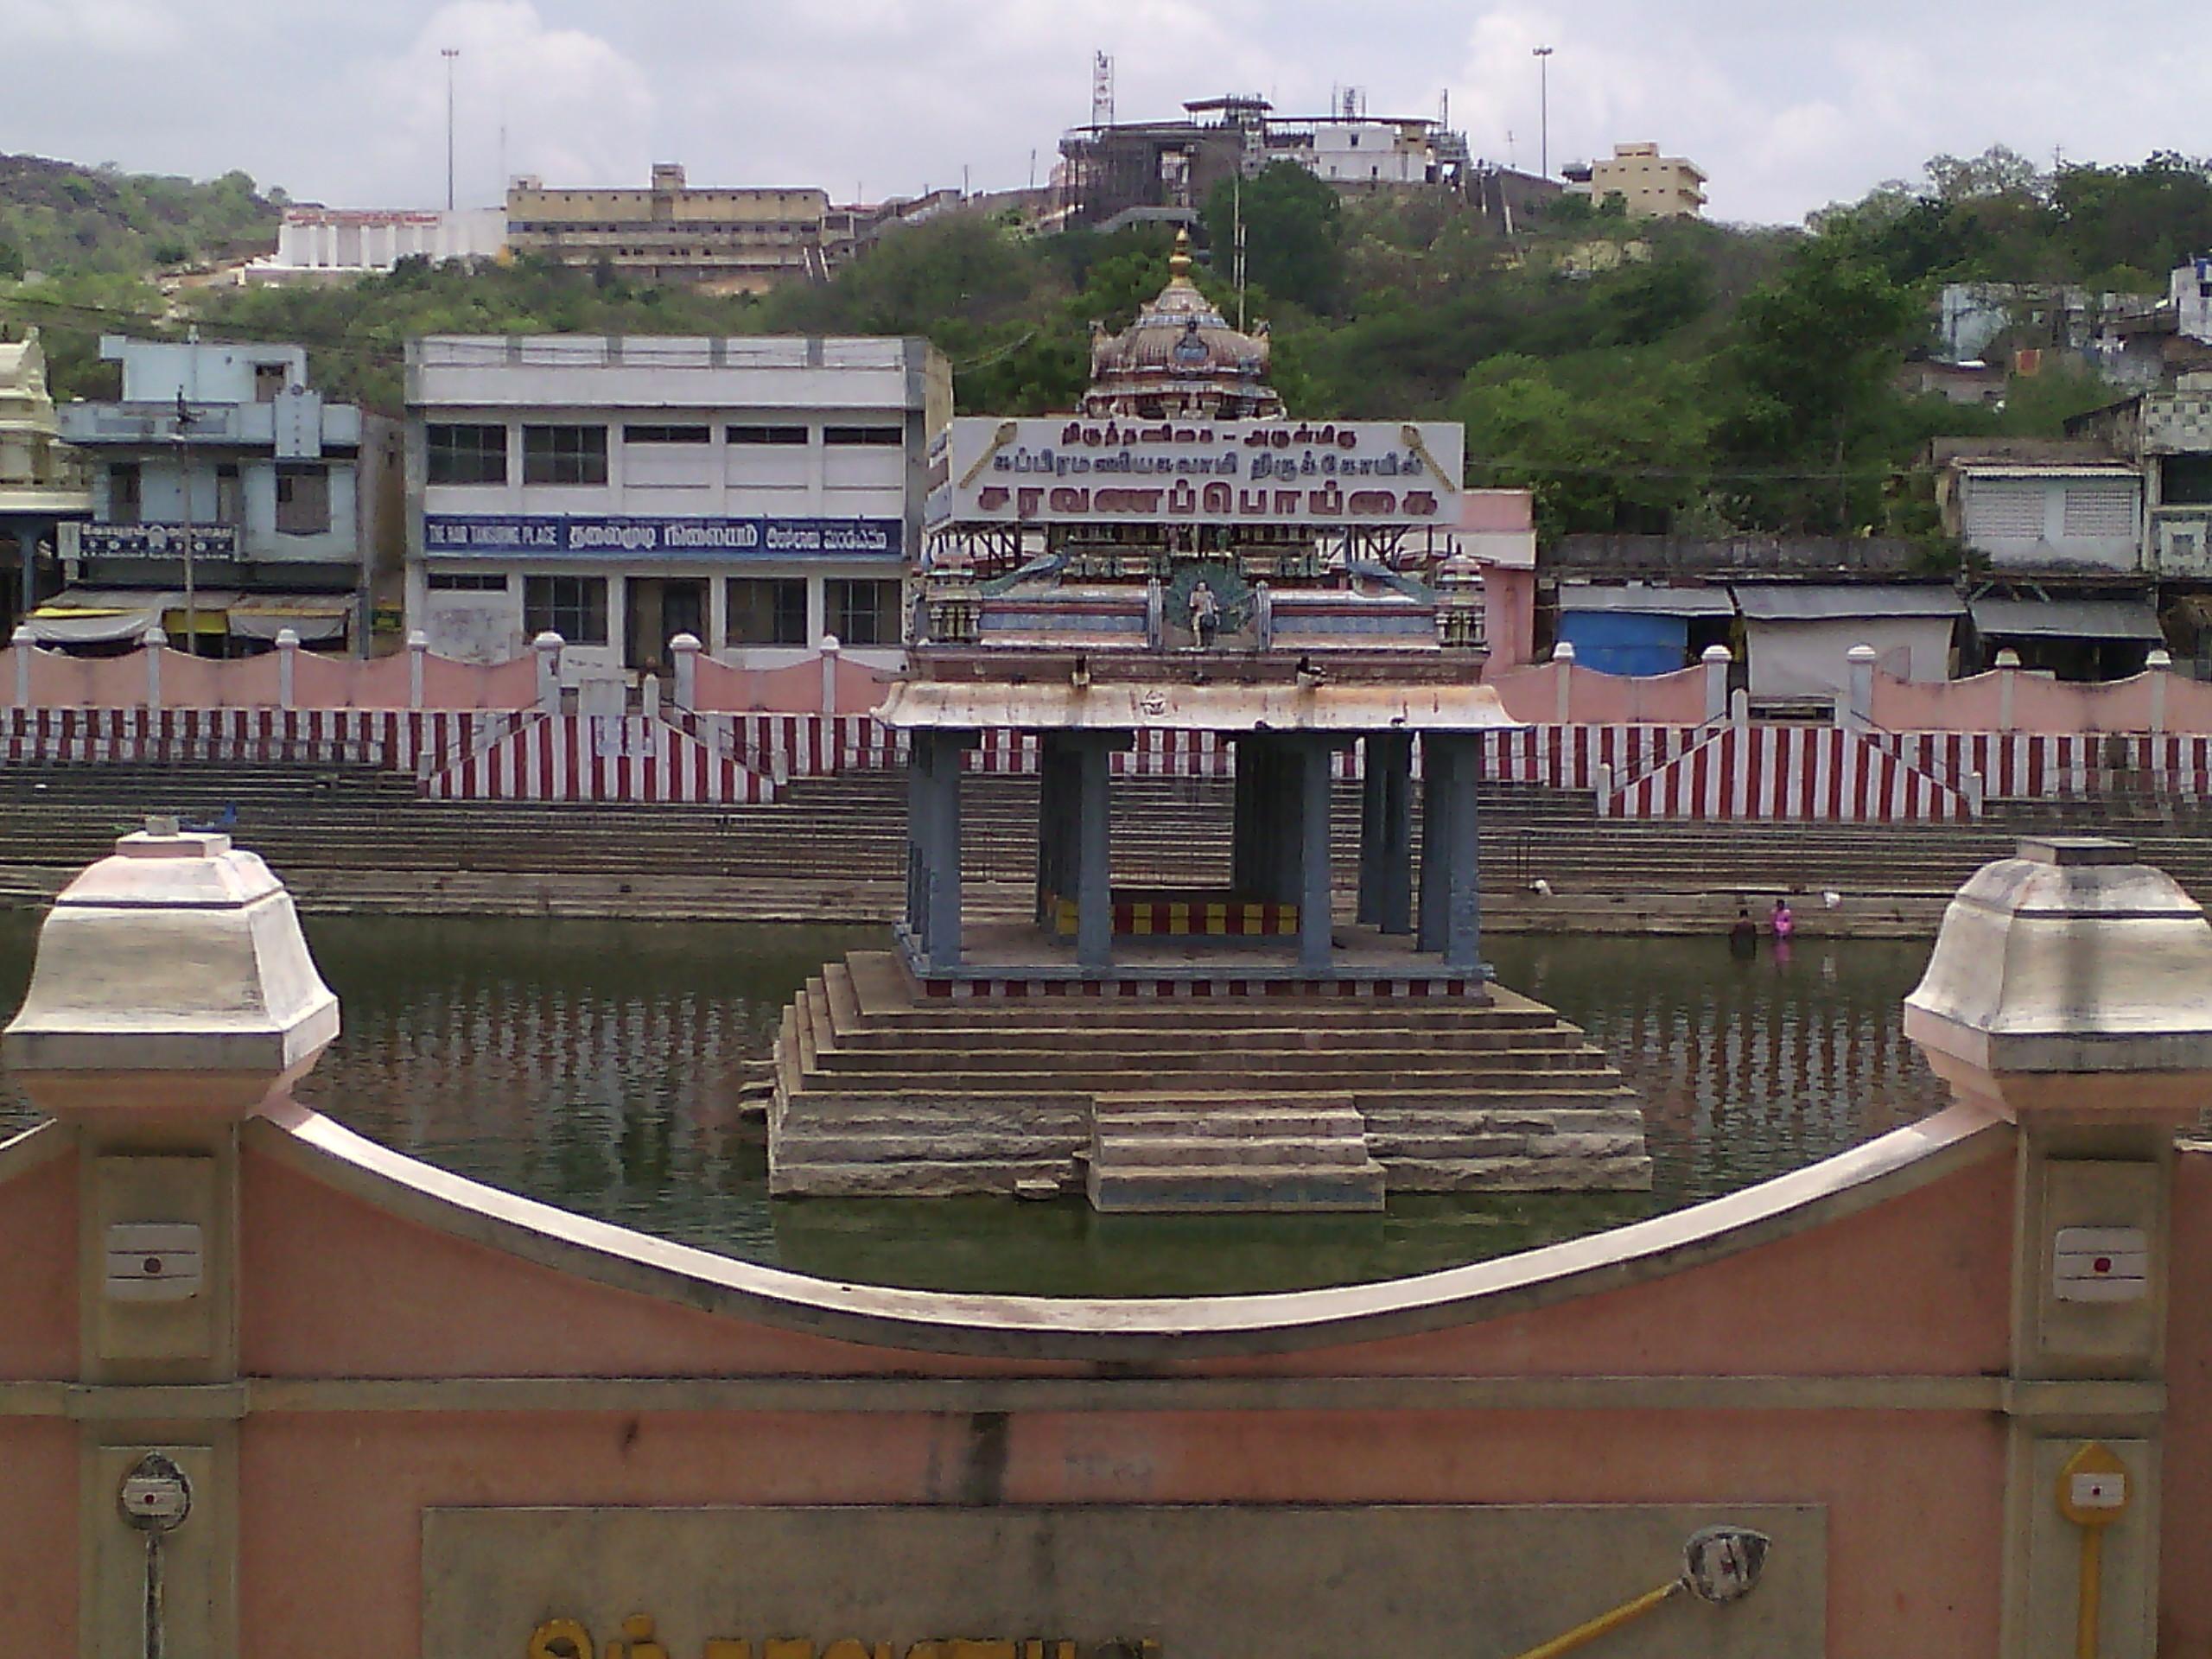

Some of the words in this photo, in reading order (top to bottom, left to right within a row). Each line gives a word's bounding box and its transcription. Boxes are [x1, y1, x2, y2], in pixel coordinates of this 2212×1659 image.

[1244, 423, 1357, 449] அருள்மிகு
[1250, 450, 1423, 481] திருக்கோயில்
[978, 479, 1438, 519] சரவணப்பொய்கை
[522, 524, 557, 545] PLACE
